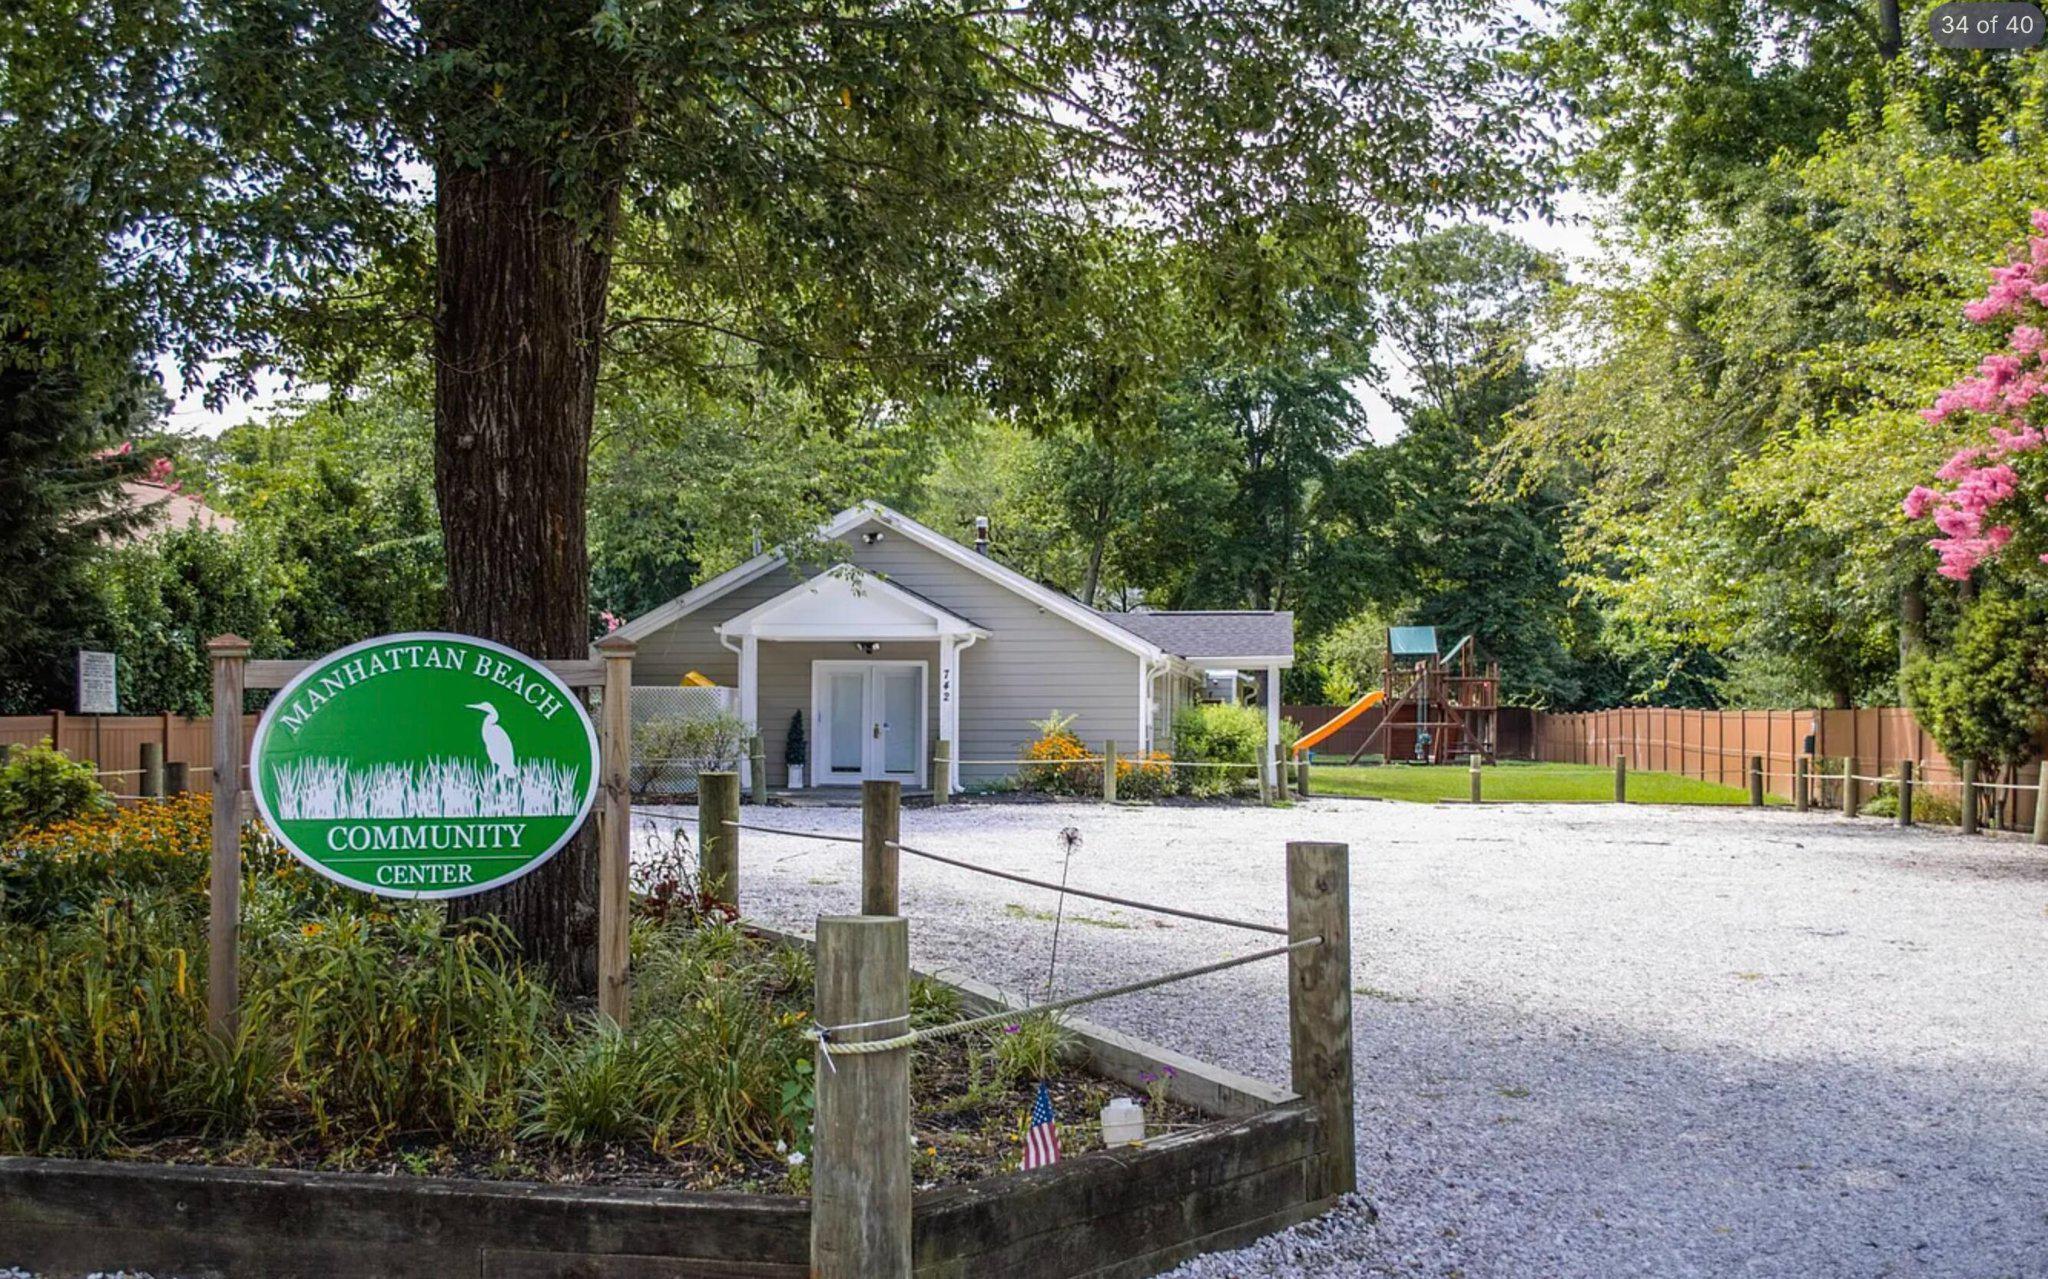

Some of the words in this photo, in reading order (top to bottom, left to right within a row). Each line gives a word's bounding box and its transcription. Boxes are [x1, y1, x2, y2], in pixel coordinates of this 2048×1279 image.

[278, 646, 468, 735] MANHATTAN
[473, 654, 564, 721] BEACH
[326, 823, 527, 852] COMMUNITY
[376, 864, 474, 885] CENTER
